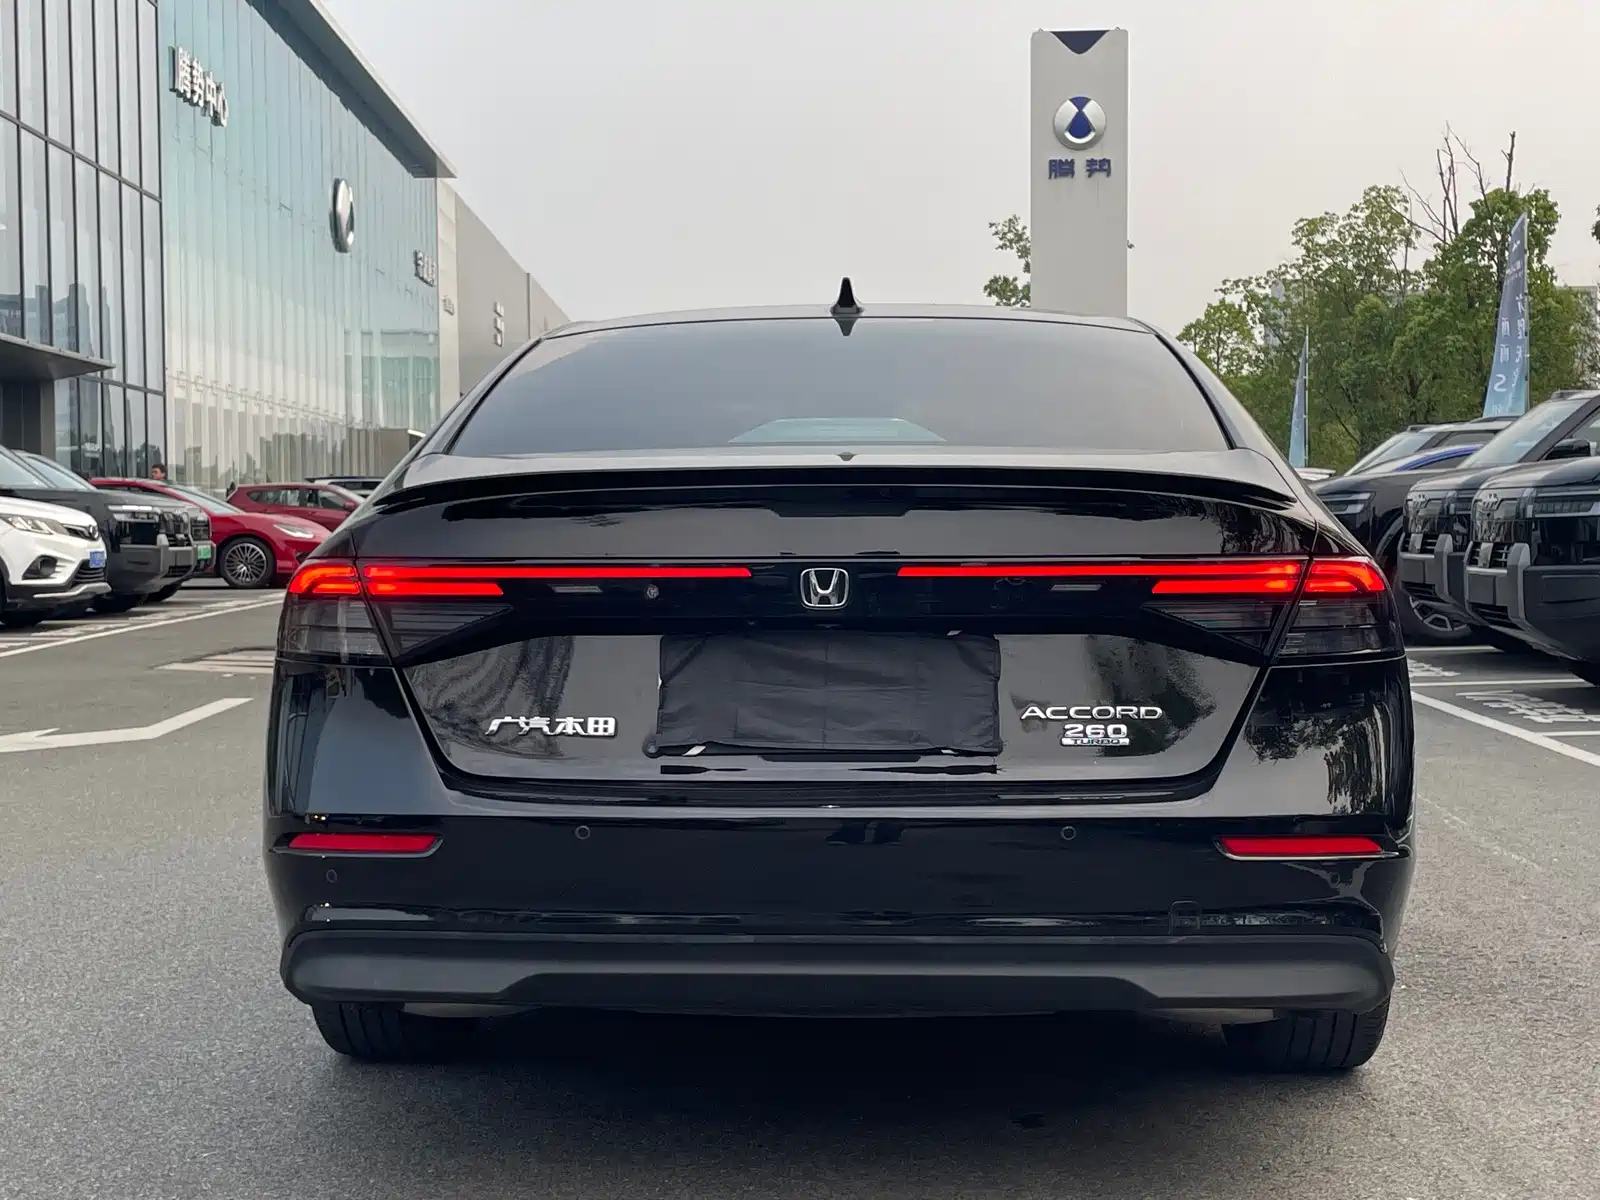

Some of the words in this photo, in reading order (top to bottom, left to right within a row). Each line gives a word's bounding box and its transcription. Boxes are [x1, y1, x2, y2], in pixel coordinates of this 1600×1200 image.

[1020, 705, 1163, 720] ACCORD
[484, 715, 616, 737] 广汽本田
[1063, 723, 1128, 738] 260
[1071, 738, 1120, 746] TURBO
